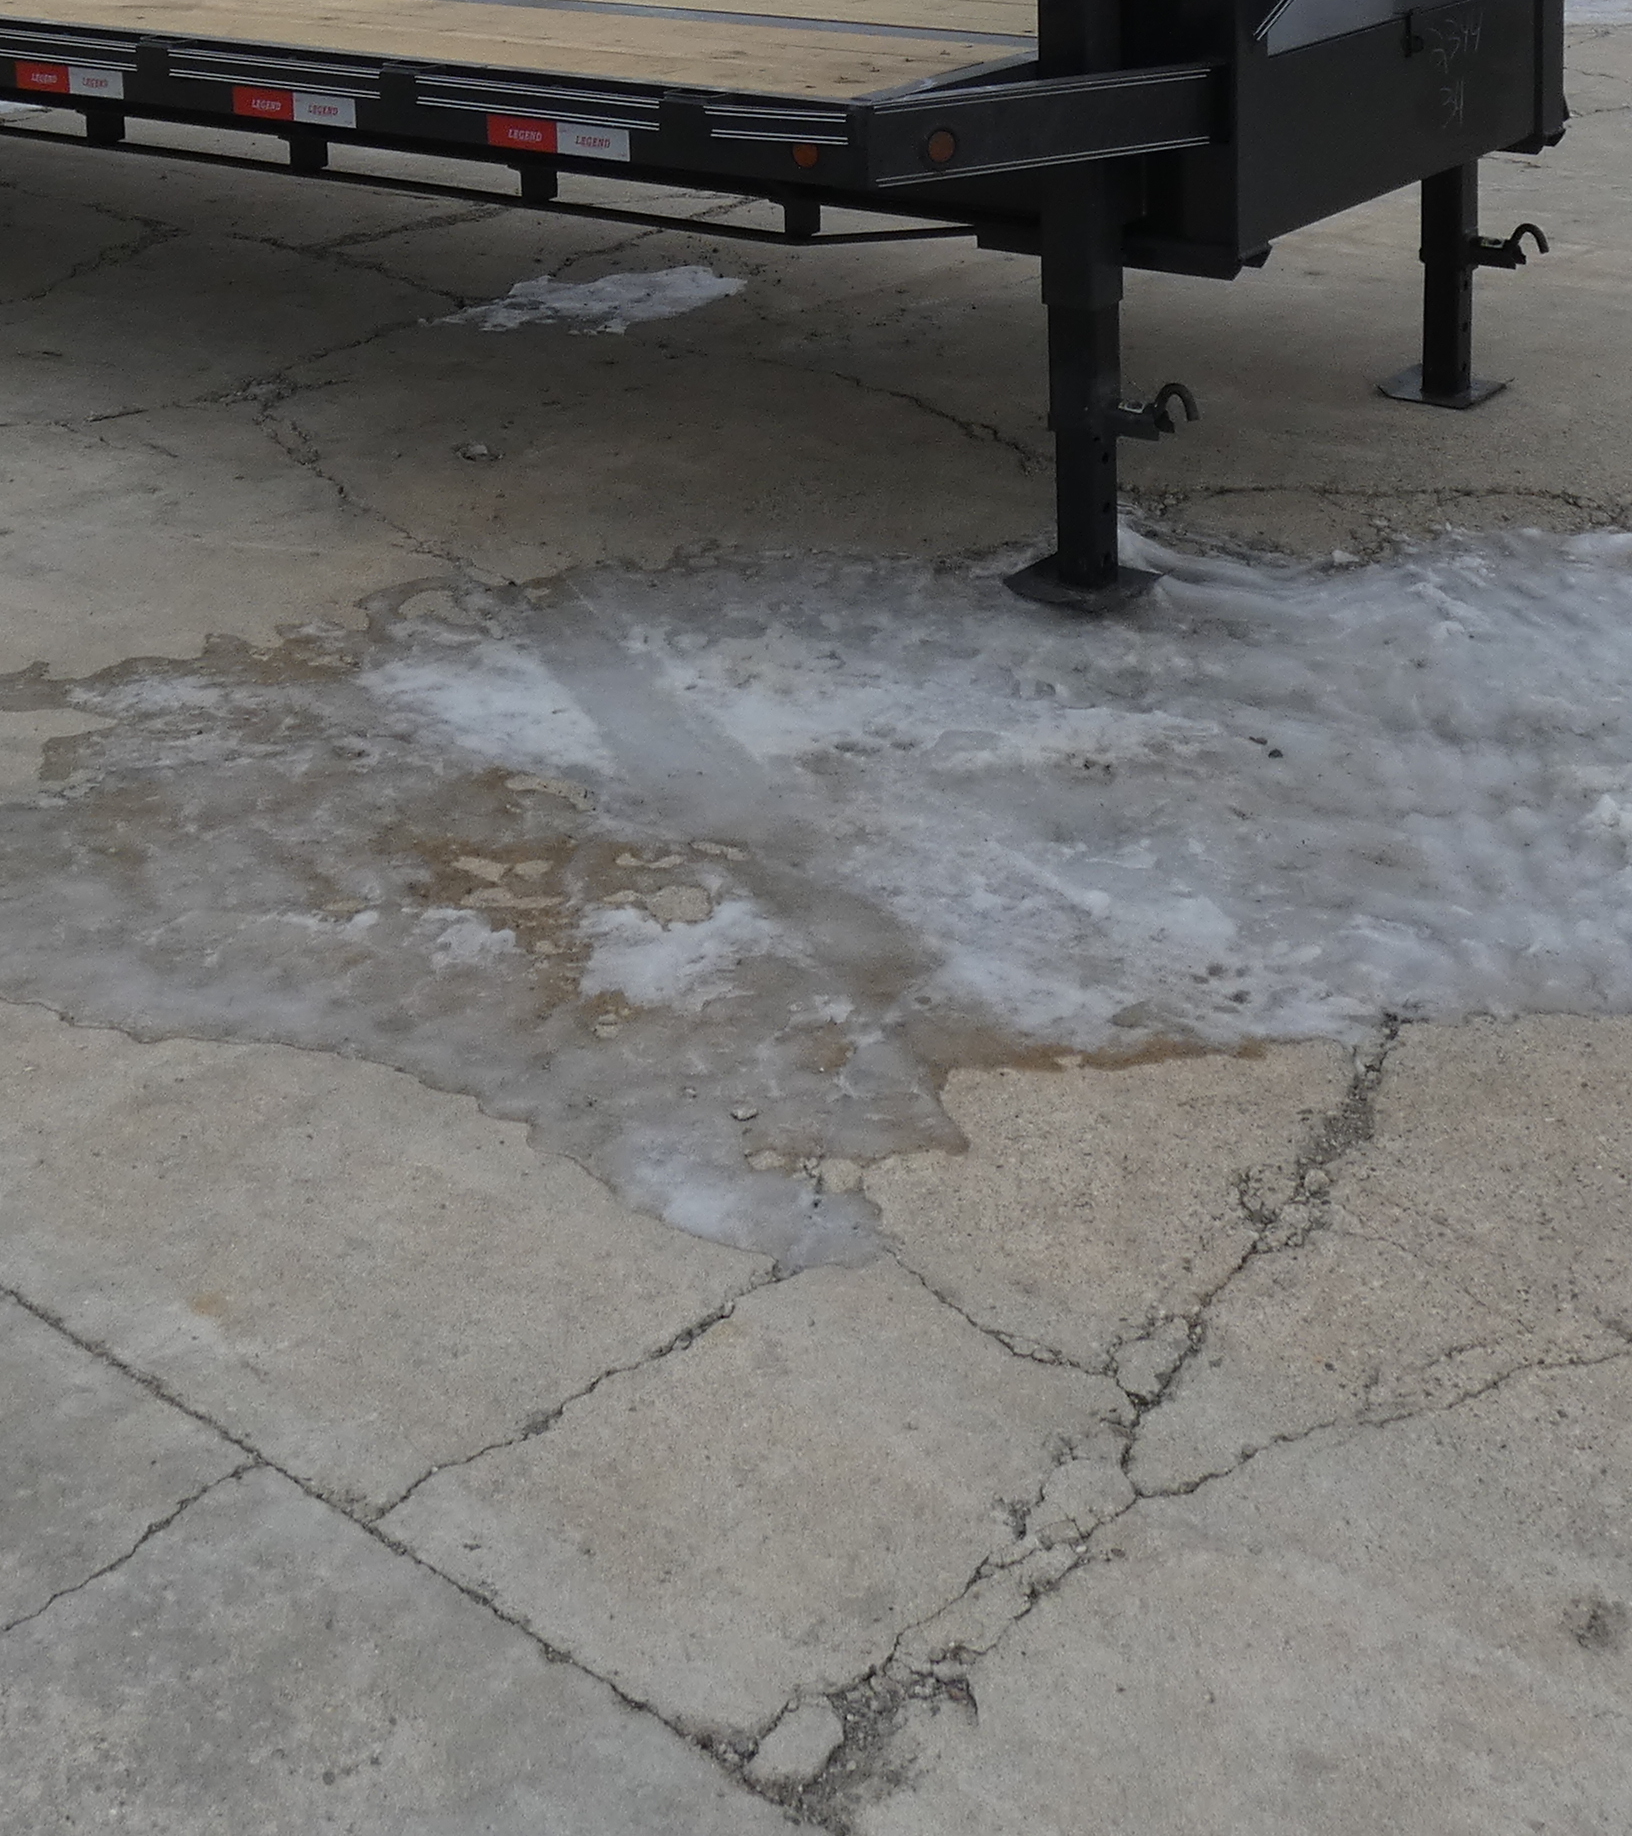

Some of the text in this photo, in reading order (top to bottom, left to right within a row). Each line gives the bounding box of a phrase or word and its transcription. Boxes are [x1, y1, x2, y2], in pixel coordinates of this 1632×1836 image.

[251, 99, 339, 116] LEGEND LEGEND
[508, 129, 611, 149] LEGEND LEGEND
